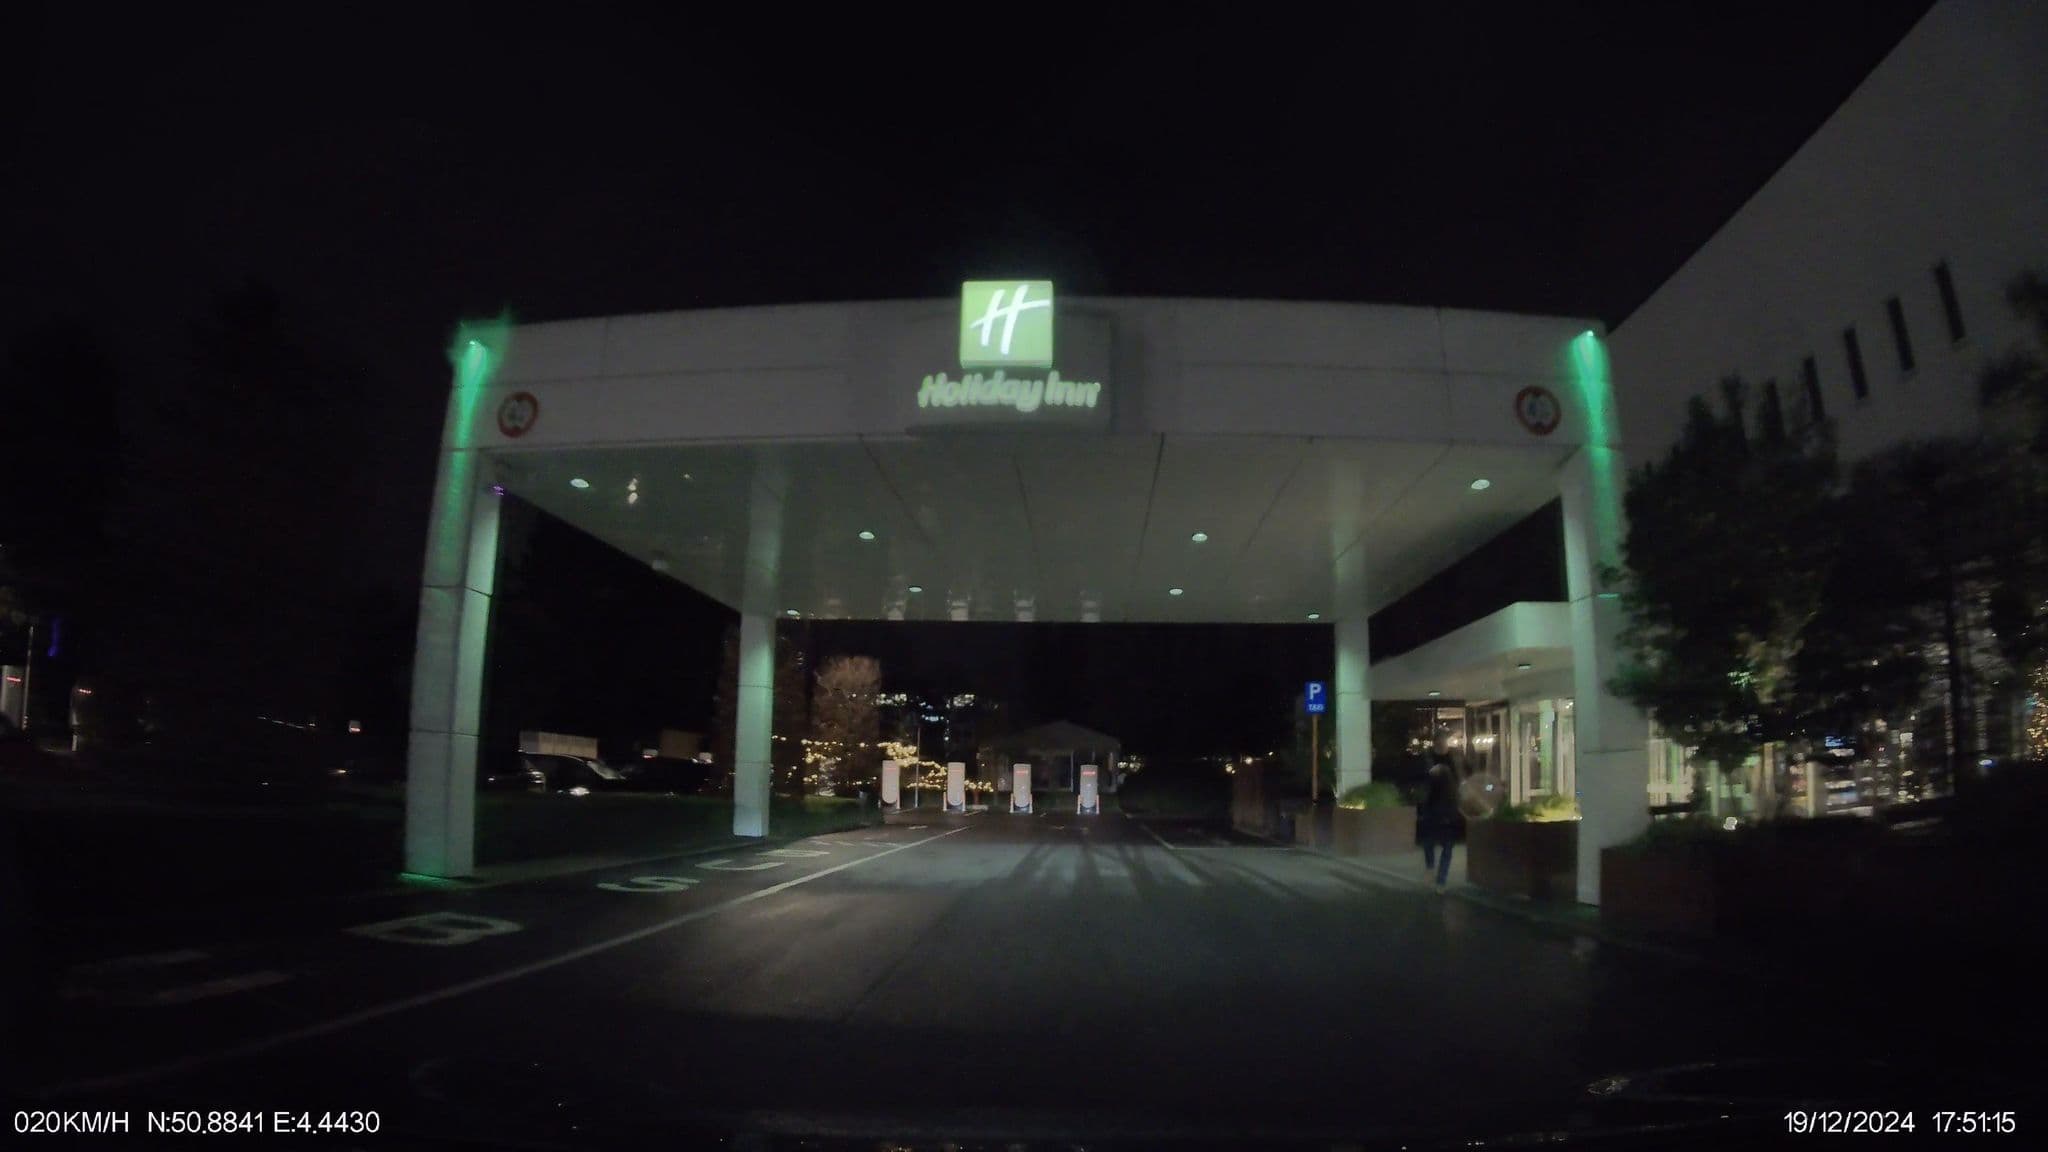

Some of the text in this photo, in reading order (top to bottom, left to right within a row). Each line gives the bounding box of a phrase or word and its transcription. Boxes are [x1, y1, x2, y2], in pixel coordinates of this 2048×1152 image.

[917, 369, 1102, 413] Holiday Inn
[1309, 683, 1322, 700] P
